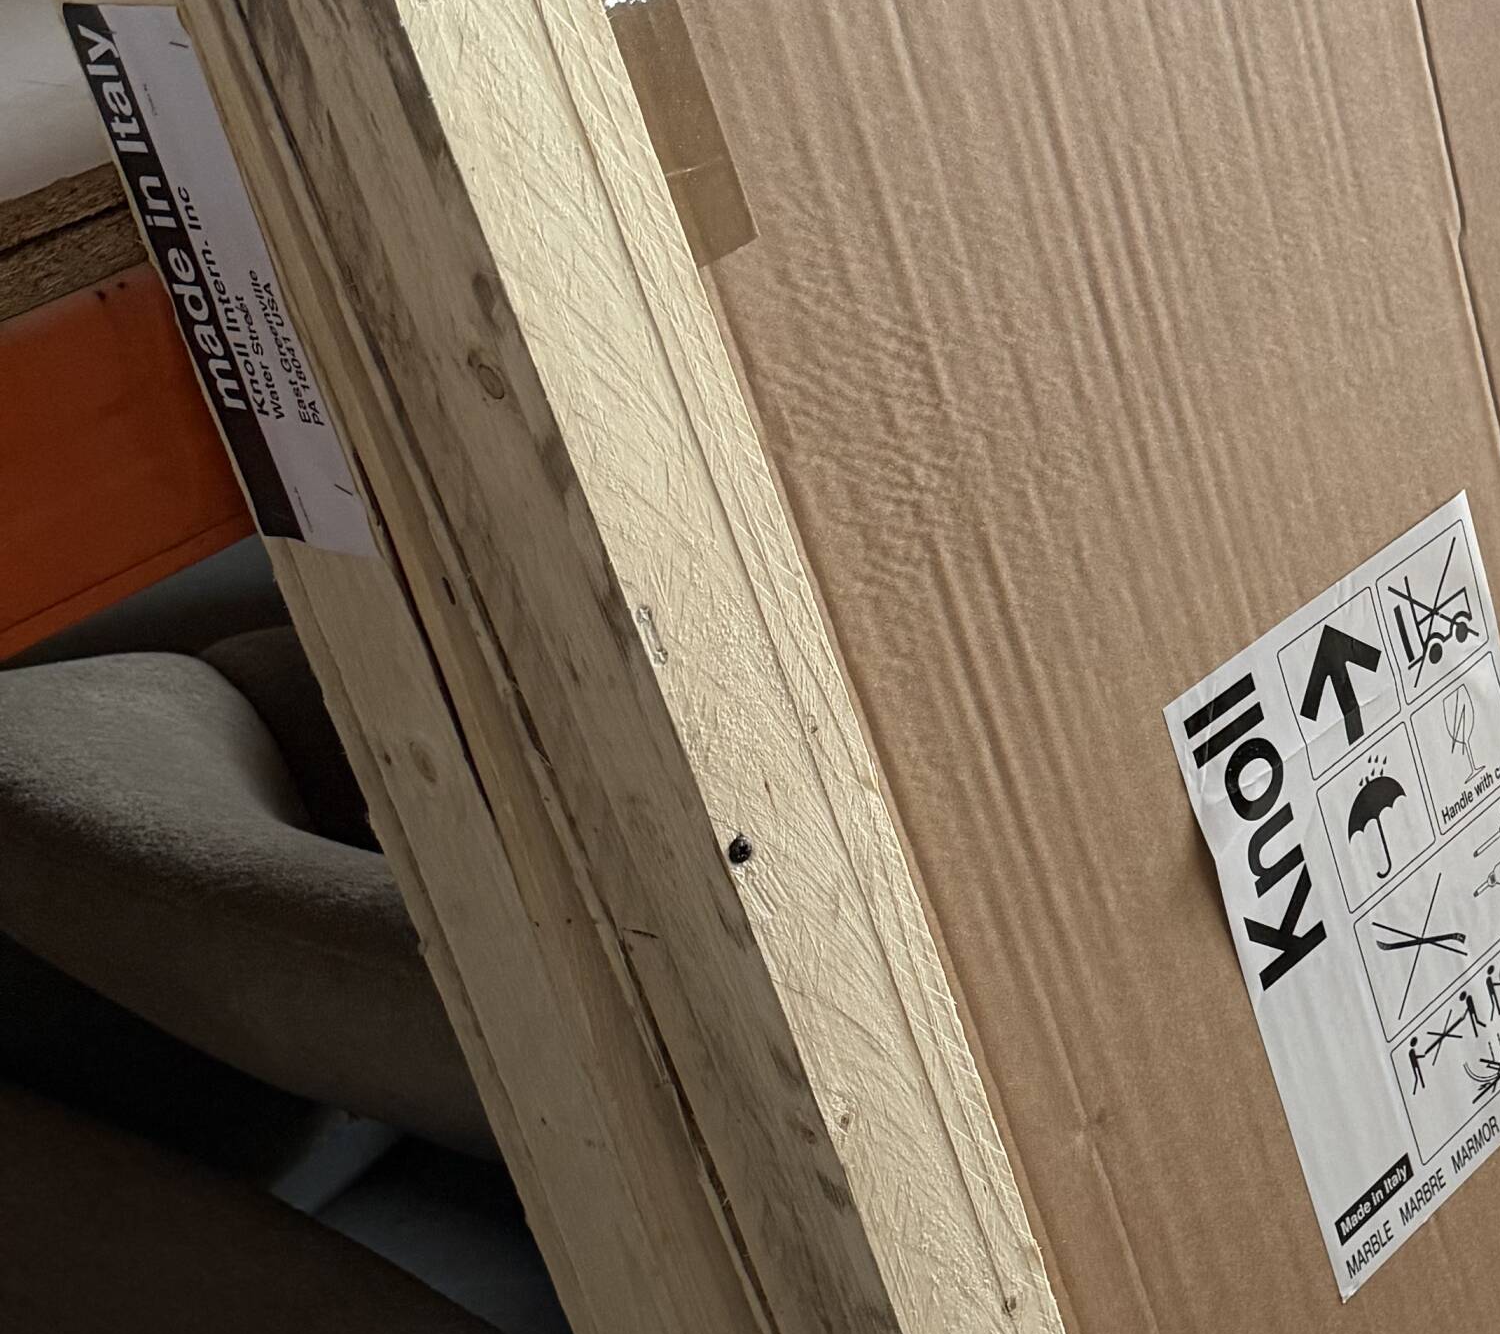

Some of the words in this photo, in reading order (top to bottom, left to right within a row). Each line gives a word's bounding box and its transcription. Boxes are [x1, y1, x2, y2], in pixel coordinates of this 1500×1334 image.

[78, 24, 149, 154] Italy
[139, 175, 177, 229] in
[178, 186, 202, 231] Inc
[200, 240, 241, 333] Intern.
[249, 269, 293, 374] Greenville
[263, 283, 285, 328] USA
[168, 247, 247, 411] made
[236, 343, 269, 417] Knoll
[258, 361, 285, 421] Water
[290, 378, 312, 425] East
[308, 400, 325, 426] PA
[1183, 672, 1327, 991] Knoll
[1441, 787, 1474, 825] Handle
[1474, 771, 1494, 801] with
[1340, 1200, 1371, 1237] Made
[1371, 1187, 1383, 1208] in
[1383, 1164, 1409, 1196] Italy
[1345, 1220, 1394, 1279] MARBLE
[1399, 1168, 1447, 1226] MARBRE
[1450, 1116, 1500, 1174] MARMOR
